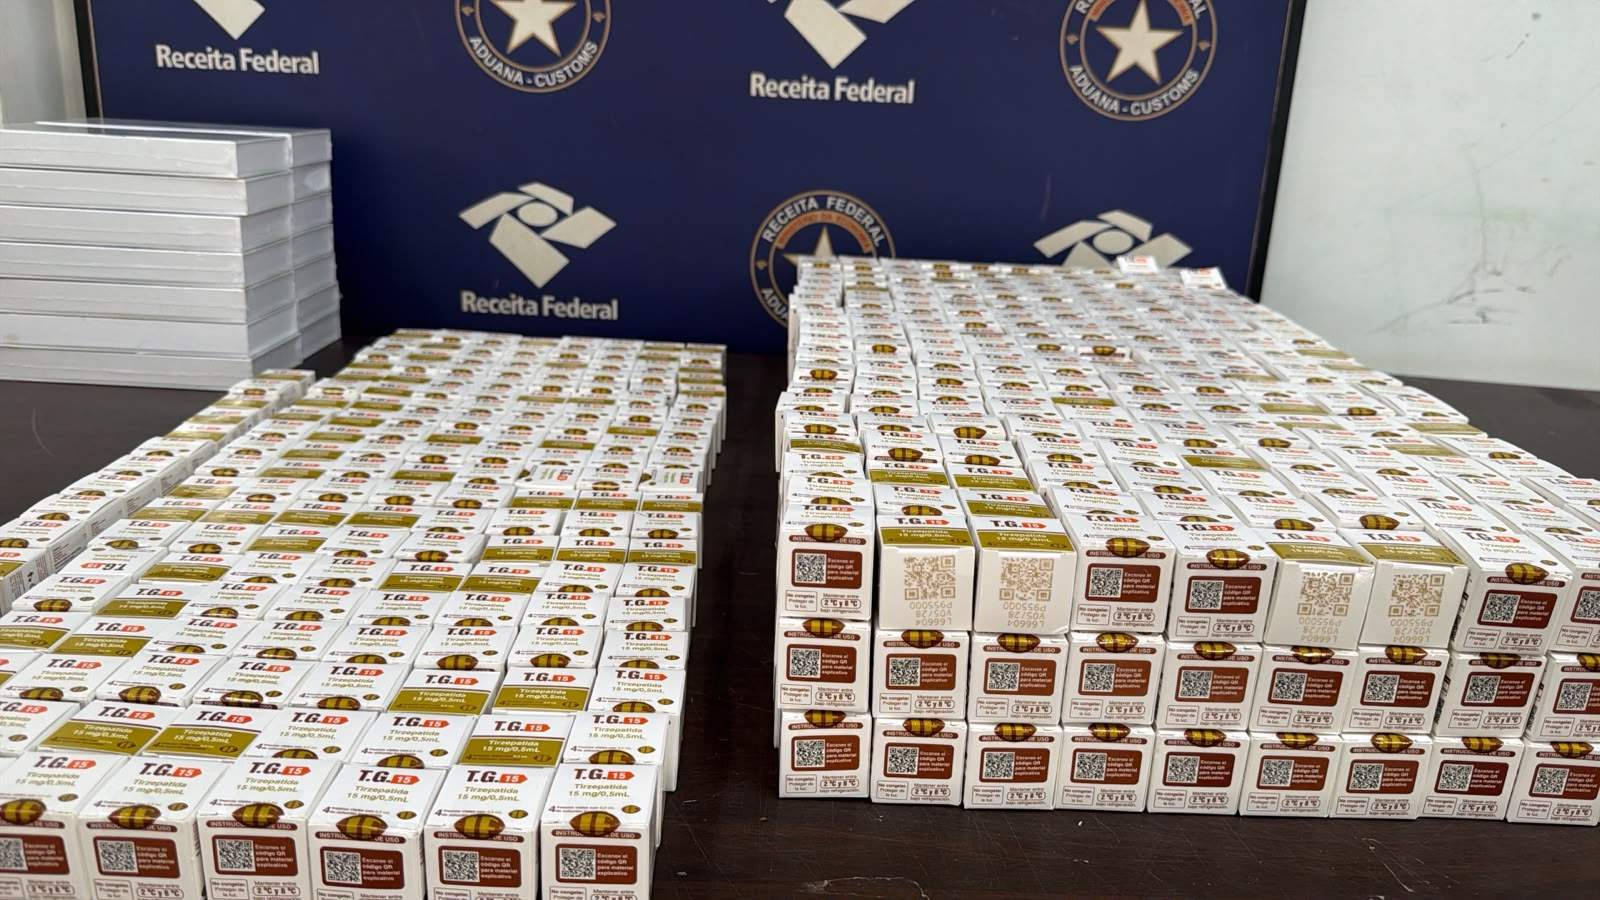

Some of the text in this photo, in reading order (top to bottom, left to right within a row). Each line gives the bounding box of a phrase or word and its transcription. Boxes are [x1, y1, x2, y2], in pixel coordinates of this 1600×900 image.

[156, 45, 320, 75] Receita Federal
[469, 36, 525, 86] ADUANA
[533, 41, 598, 88] CUSTOMS
[750, 72, 915, 104] Receita Federal
[1069, 65, 1121, 114] ADUANA
[1130, 68, 1200, 115] CUSTOMS
[762, 196, 819, 243] RECEITA
[825, 196, 885, 247] FEDERAL
[461, 291, 619, 321] Receita Federal
[354, 785, 409, 794] Tirzepatida
[464, 786, 519, 795] Tirzepatida
[574, 783, 628, 791] Tirzepatida
